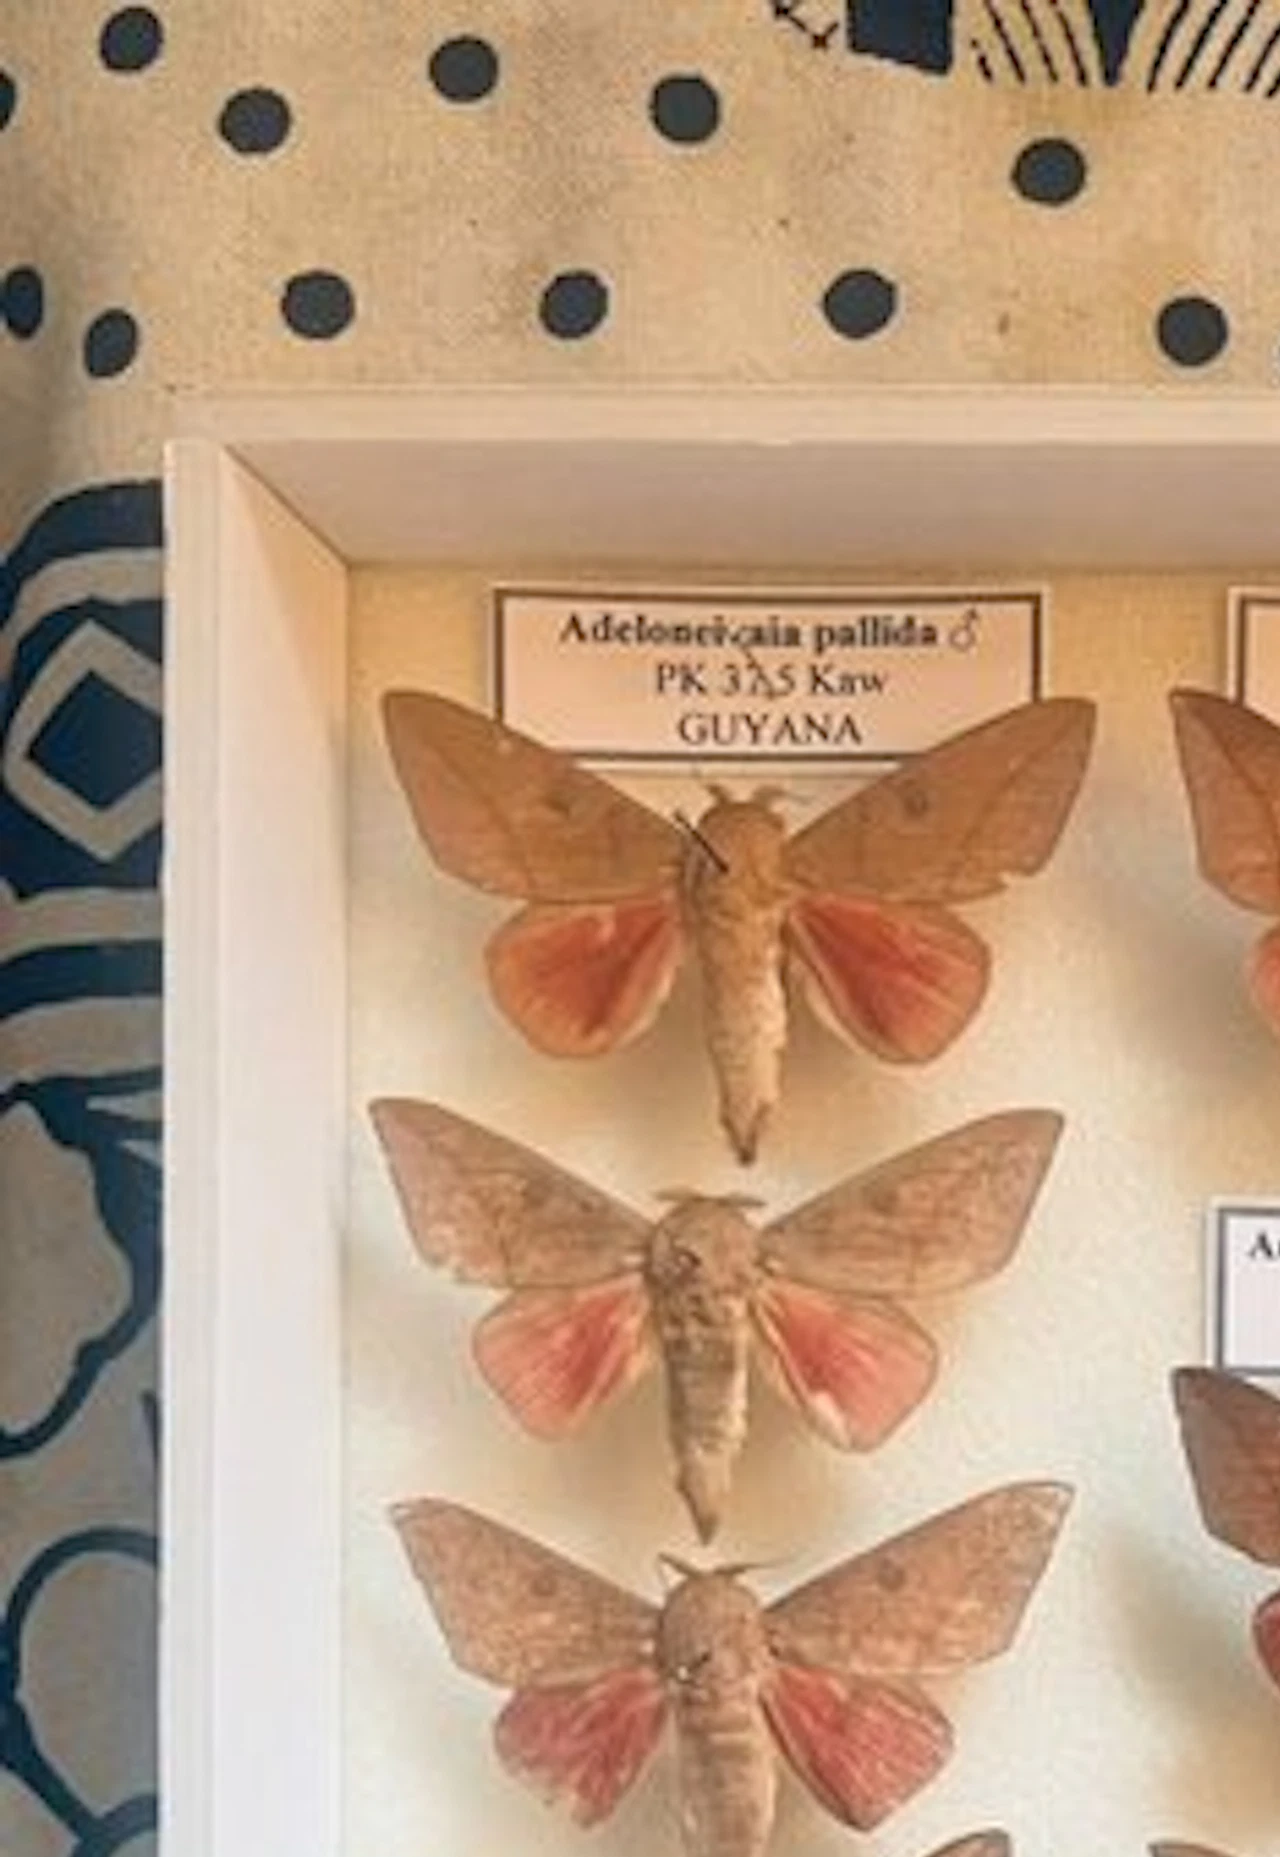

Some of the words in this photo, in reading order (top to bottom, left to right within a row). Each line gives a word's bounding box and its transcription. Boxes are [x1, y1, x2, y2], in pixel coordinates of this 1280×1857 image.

[815, 613, 938, 654] pallida
[655, 664, 708, 696] PK
[810, 665, 886, 696] Kaw
[679, 713, 862, 745] GUYANA
